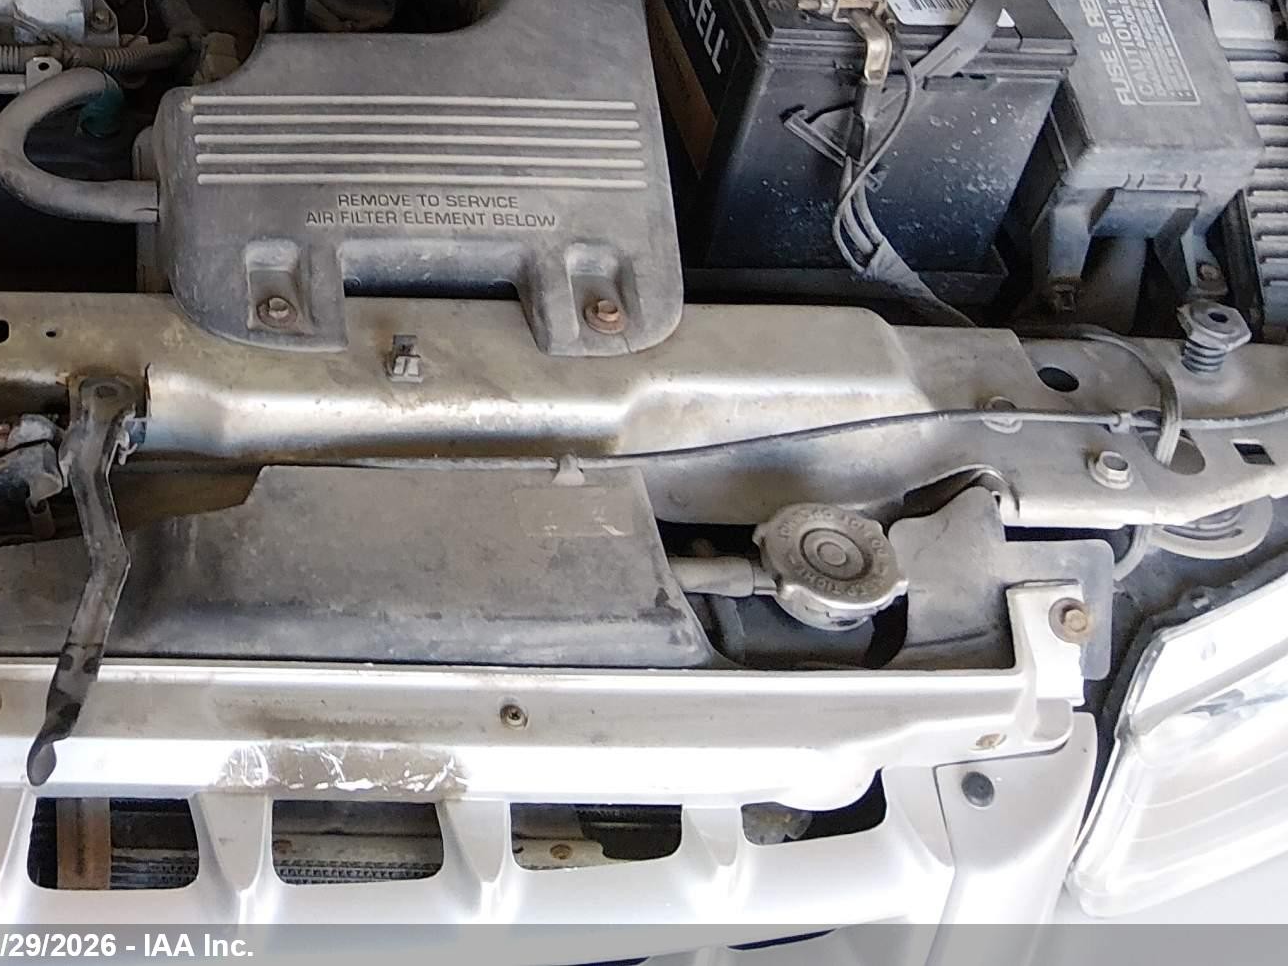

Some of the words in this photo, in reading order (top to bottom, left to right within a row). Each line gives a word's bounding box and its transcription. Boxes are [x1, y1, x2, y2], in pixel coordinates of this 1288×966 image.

[1098, 31, 1113, 45] &
[1106, 8, 1153, 96] CAUTION!
[1101, 48, 1138, 106] FUSE
[337, 194, 411, 207] REMOVE
[416, 194, 440, 207] TO
[446, 195, 519, 209] SERVICE
[305, 210, 334, 224] AIR
[341, 210, 398, 225] FILTER
[404, 211, 486, 226] ELEMENT
[493, 214, 556, 227] BELOW
